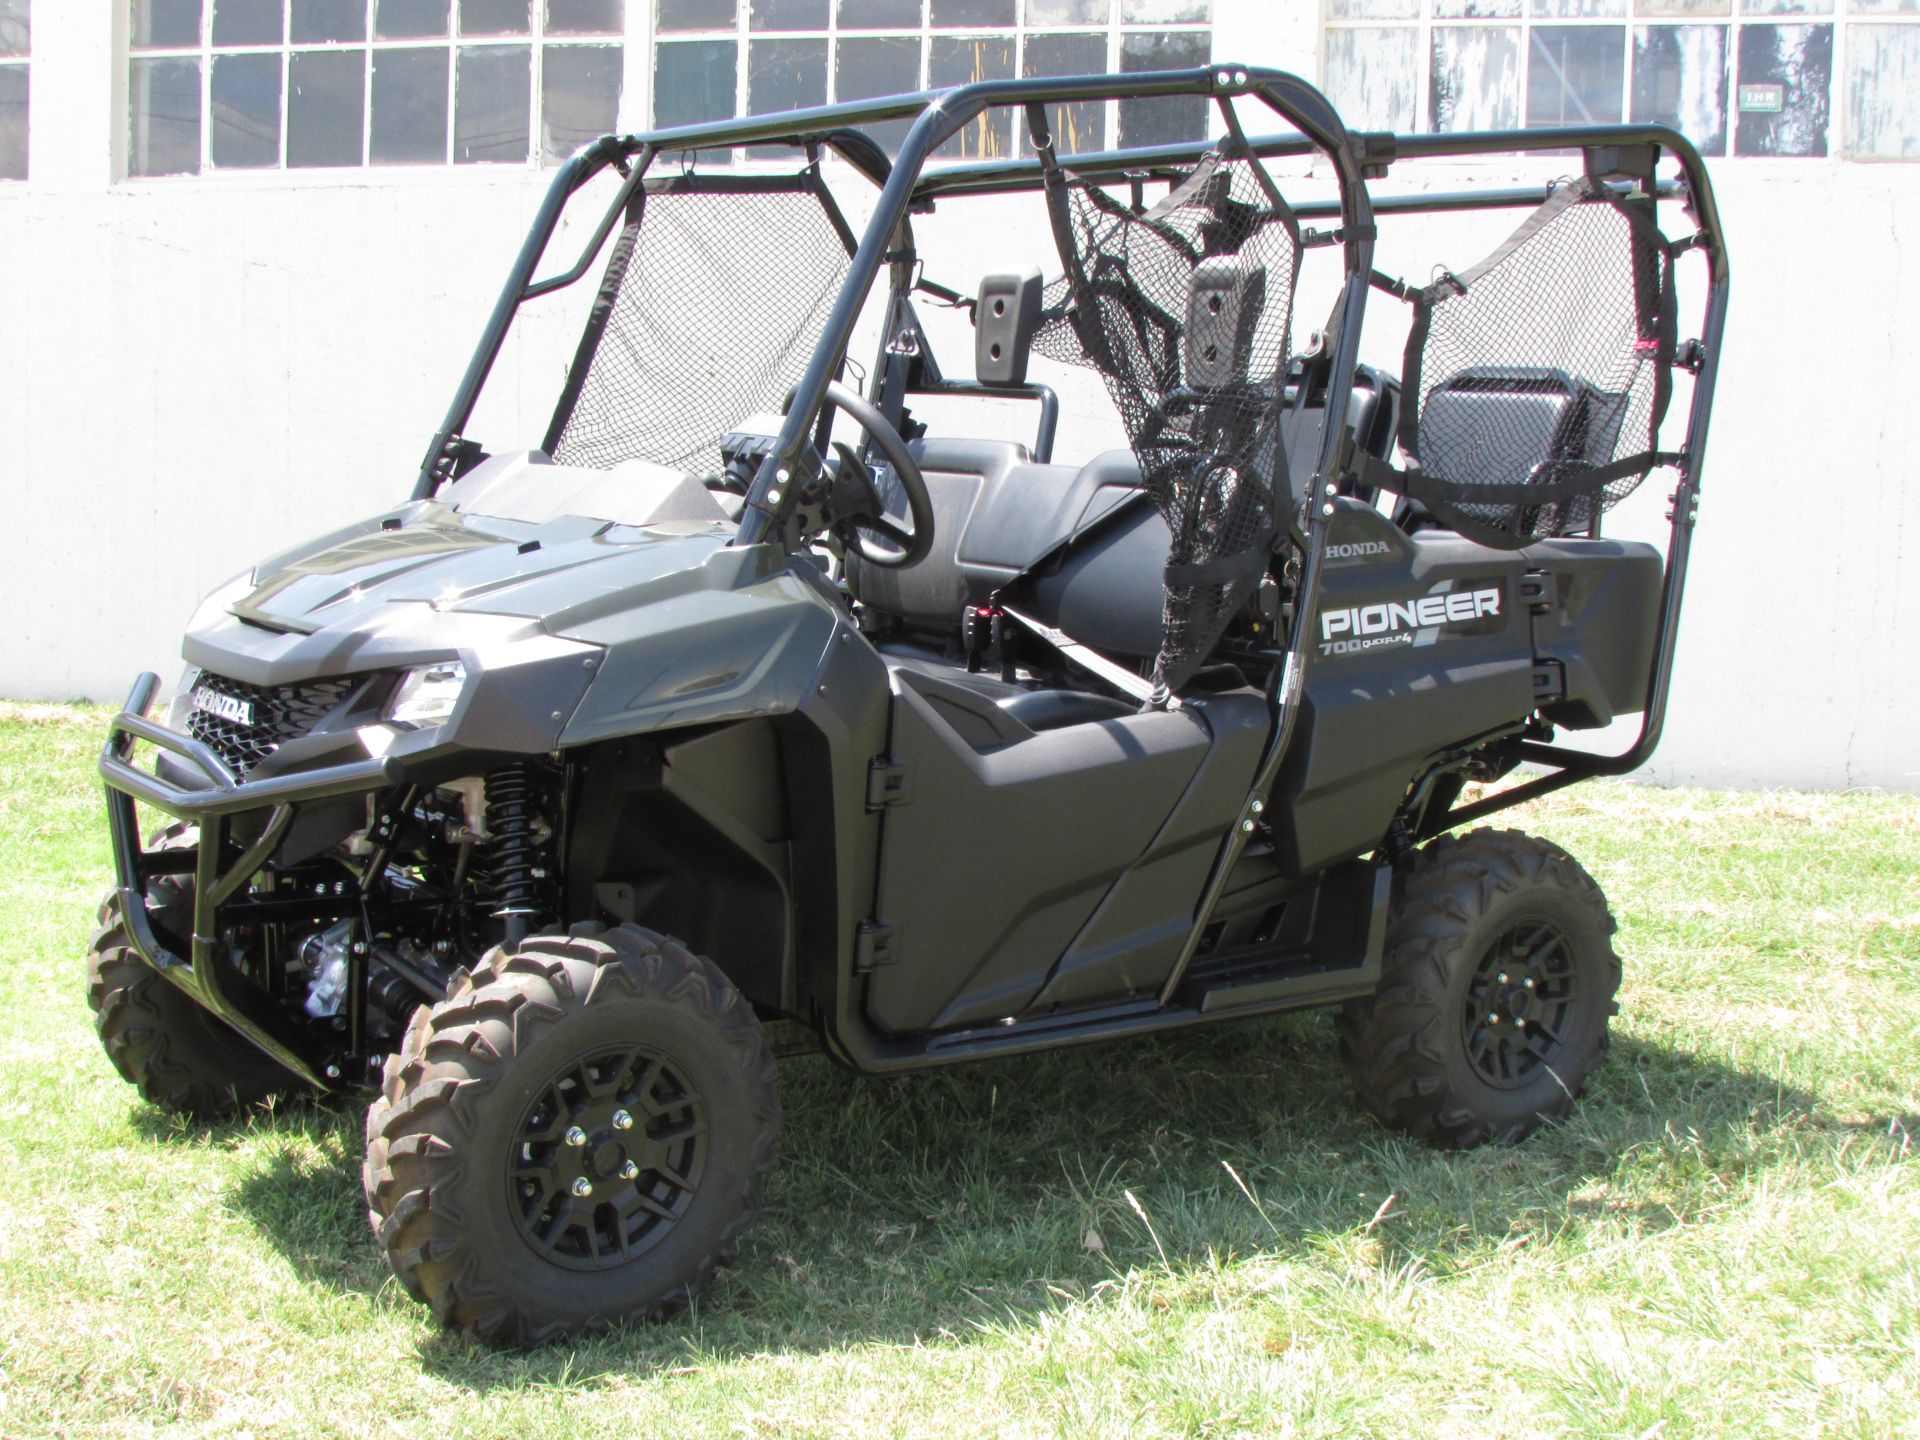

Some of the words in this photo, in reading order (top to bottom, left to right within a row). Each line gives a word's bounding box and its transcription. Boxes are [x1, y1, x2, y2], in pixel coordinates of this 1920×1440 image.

[1325, 541, 1390, 559] HONDA
[1321, 587, 1500, 640] PIONEER
[1319, 640, 1362, 656] 700
[193, 685, 253, 727] HONDA
